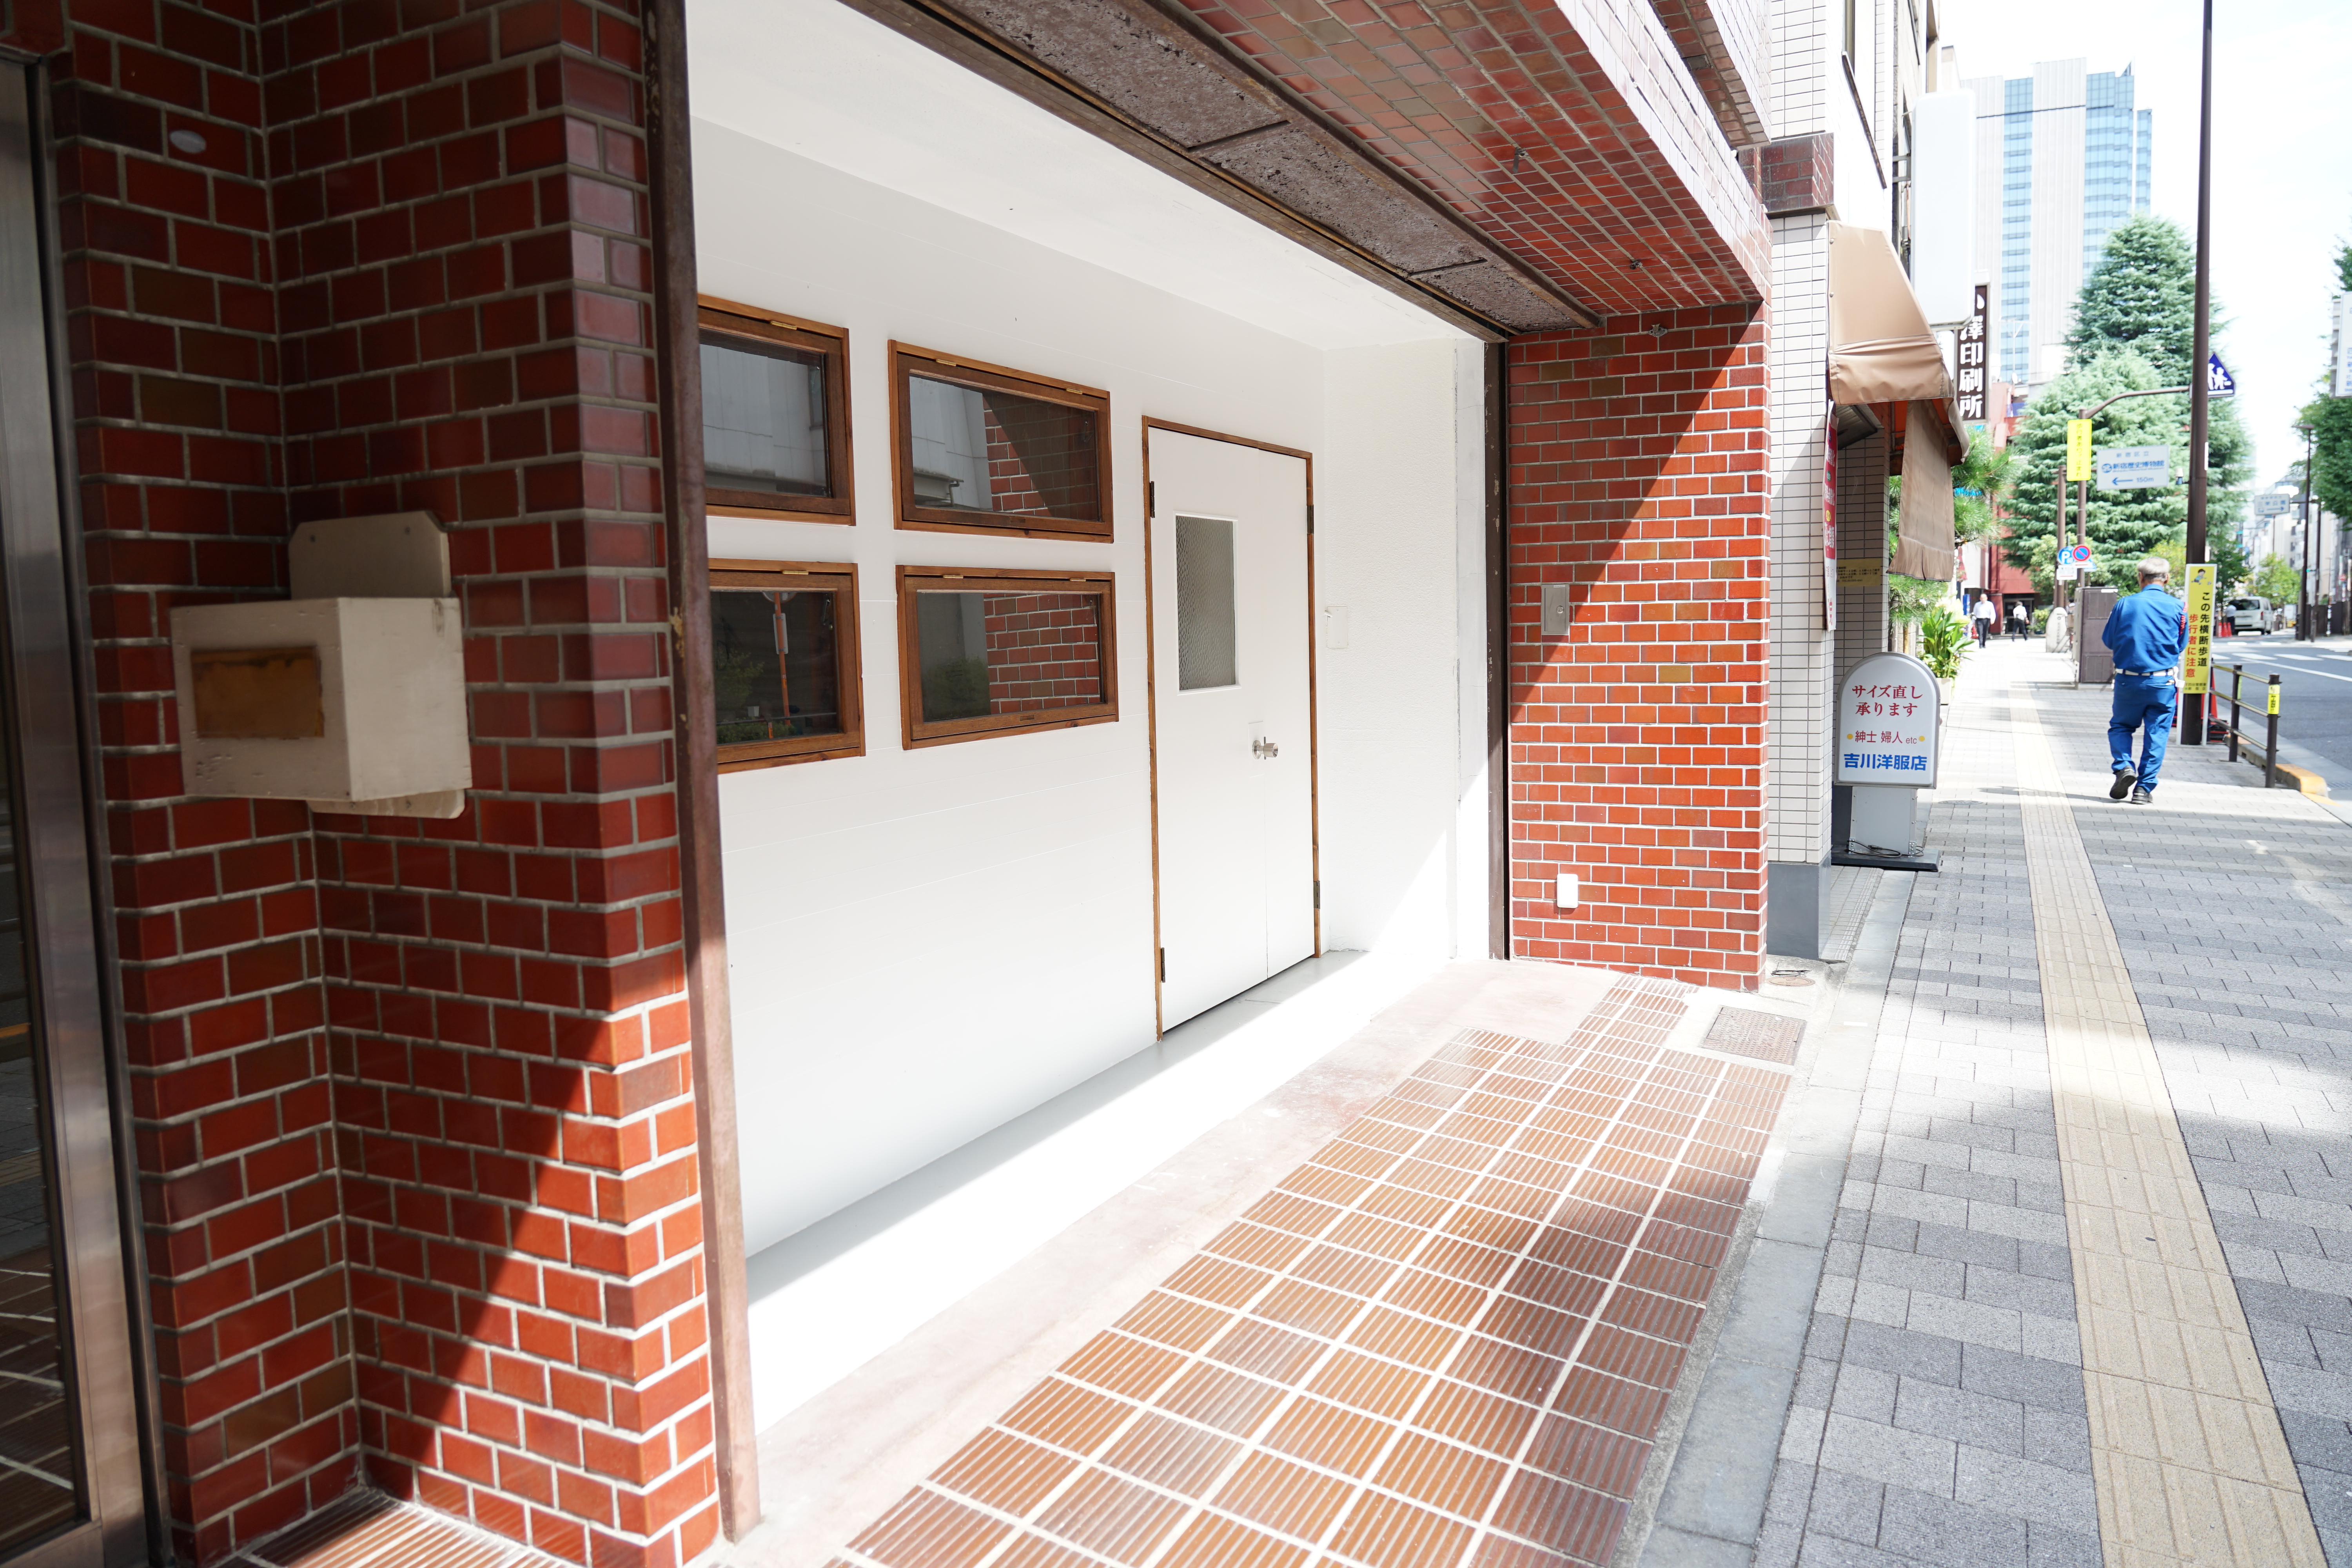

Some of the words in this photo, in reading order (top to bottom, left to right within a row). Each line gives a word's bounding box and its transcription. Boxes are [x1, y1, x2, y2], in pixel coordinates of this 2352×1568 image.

[2198, 592, 2210, 666] この先横断歩道
[2185, 614, 2198, 677] 歩行者に注意
[1852, 685, 1923, 699] サイズ直し
[1855, 702, 1918, 717] 承ります
[1855, 730, 1877, 742] 紳士
[1881, 731, 1902, 744] 婦人
[1844, 753, 1927, 771] 吉川洋服店
